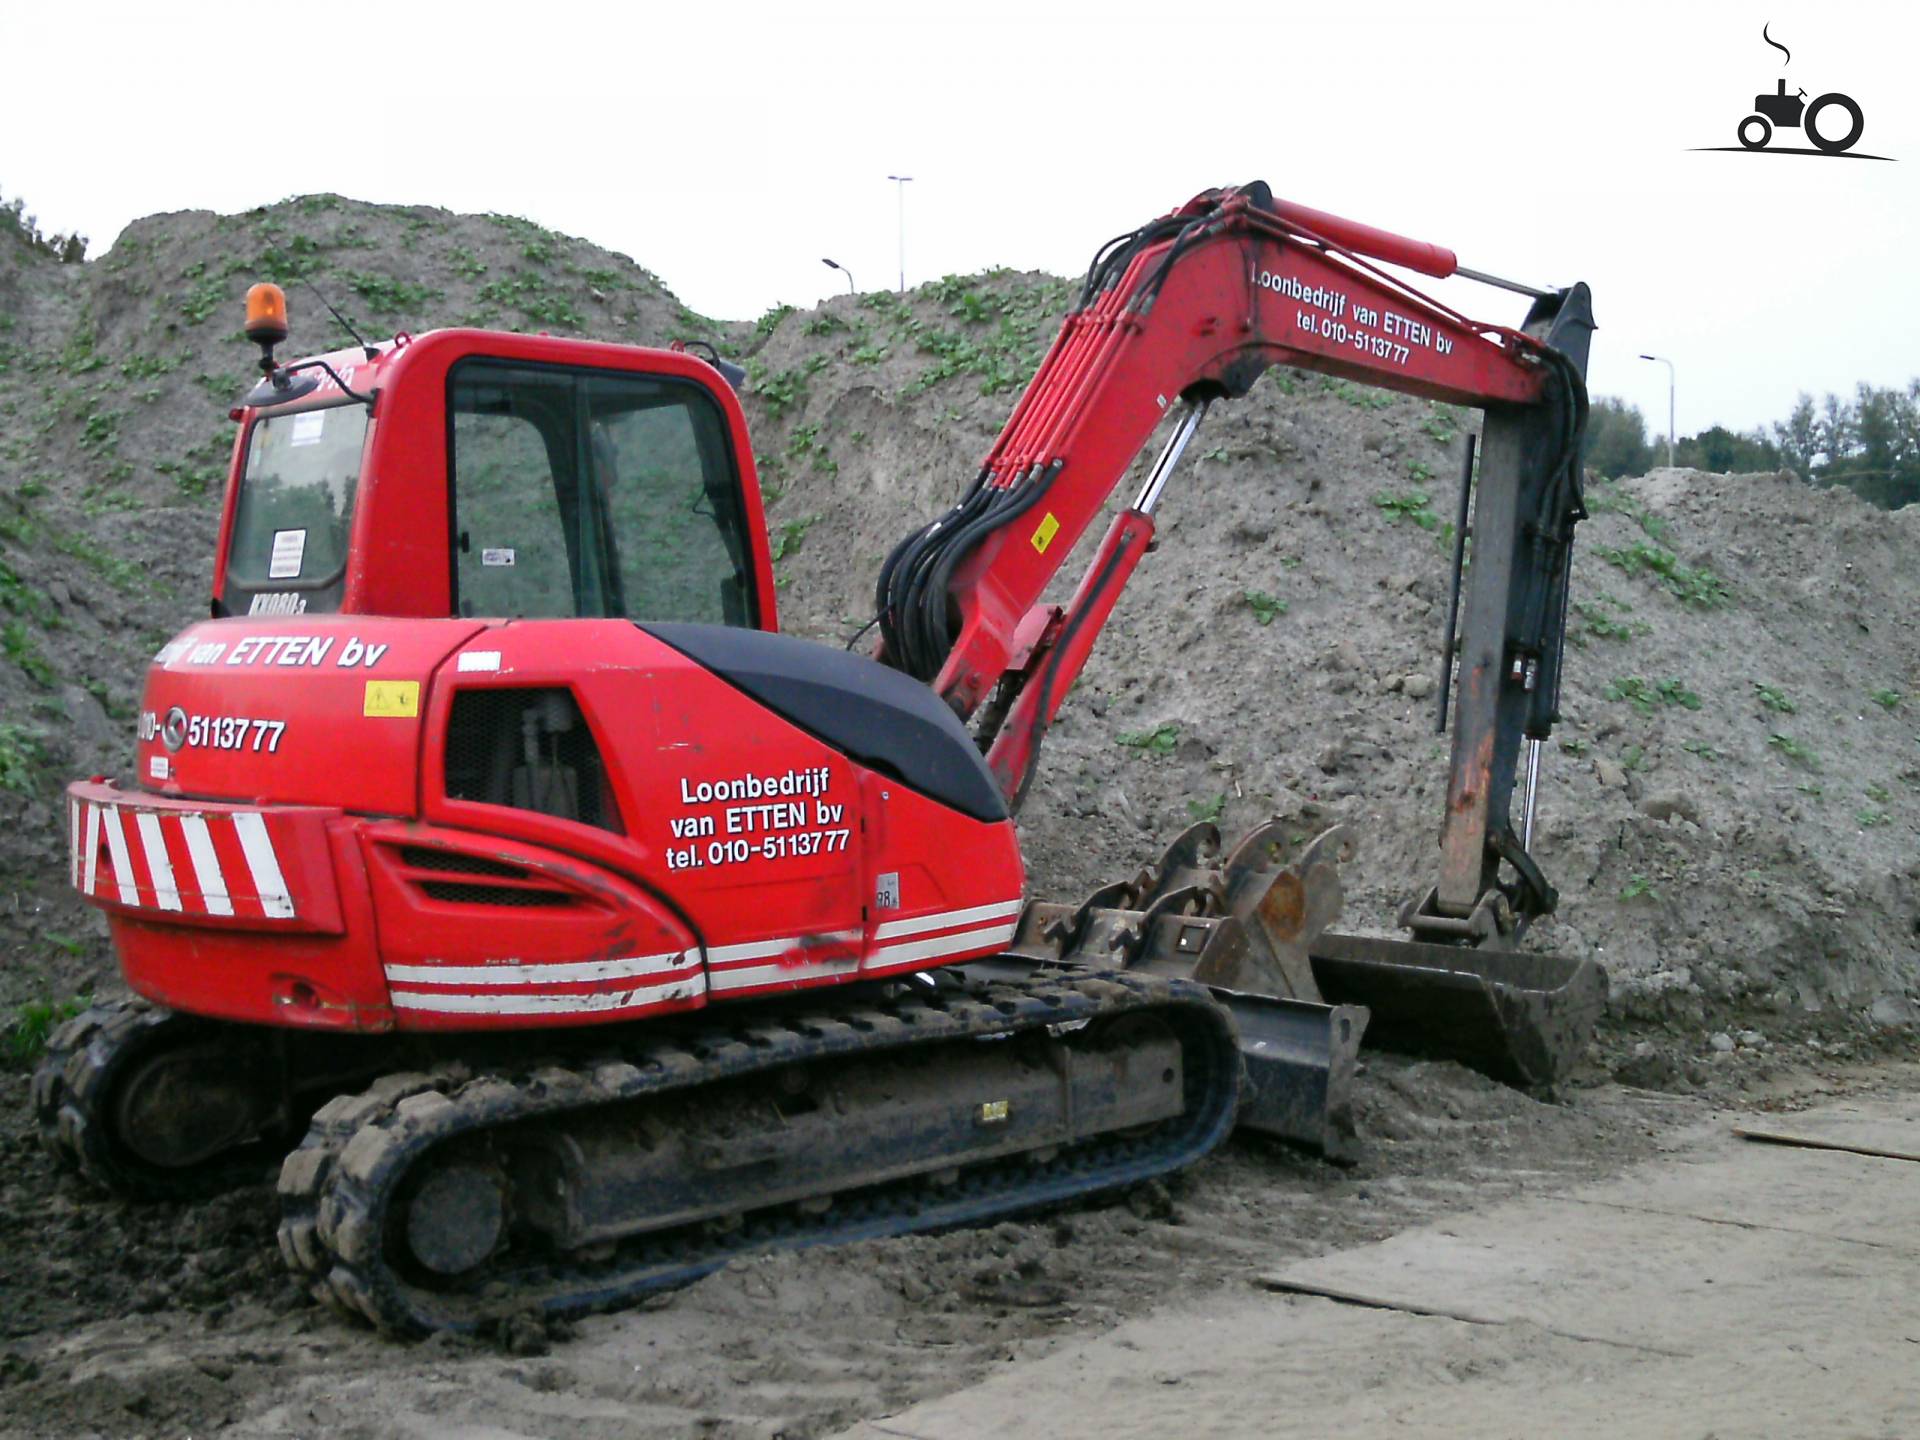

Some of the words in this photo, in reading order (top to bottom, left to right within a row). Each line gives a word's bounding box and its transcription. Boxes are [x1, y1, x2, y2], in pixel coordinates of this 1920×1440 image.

[1251, 262, 1346, 317] Loonbedrijf
[1352, 304, 1378, 328] van
[1383, 311, 1431, 347] ETTEN
[1436, 331, 1453, 354] bv
[1296, 309, 1319, 334] tel.
[1321, 318, 1410, 364] 010-5113777
[187, 643, 227, 665] van
[226, 637, 334, 666] ETTEN
[337, 637, 388, 667] bv
[681, 767, 830, 804] Loonbedrijf
[670, 815, 715, 838] van
[726, 802, 807, 833] ETTEN
[816, 800, 843, 825] bv
[666, 845, 704, 869] tel.
[708, 829, 850, 865] 010-5113777
